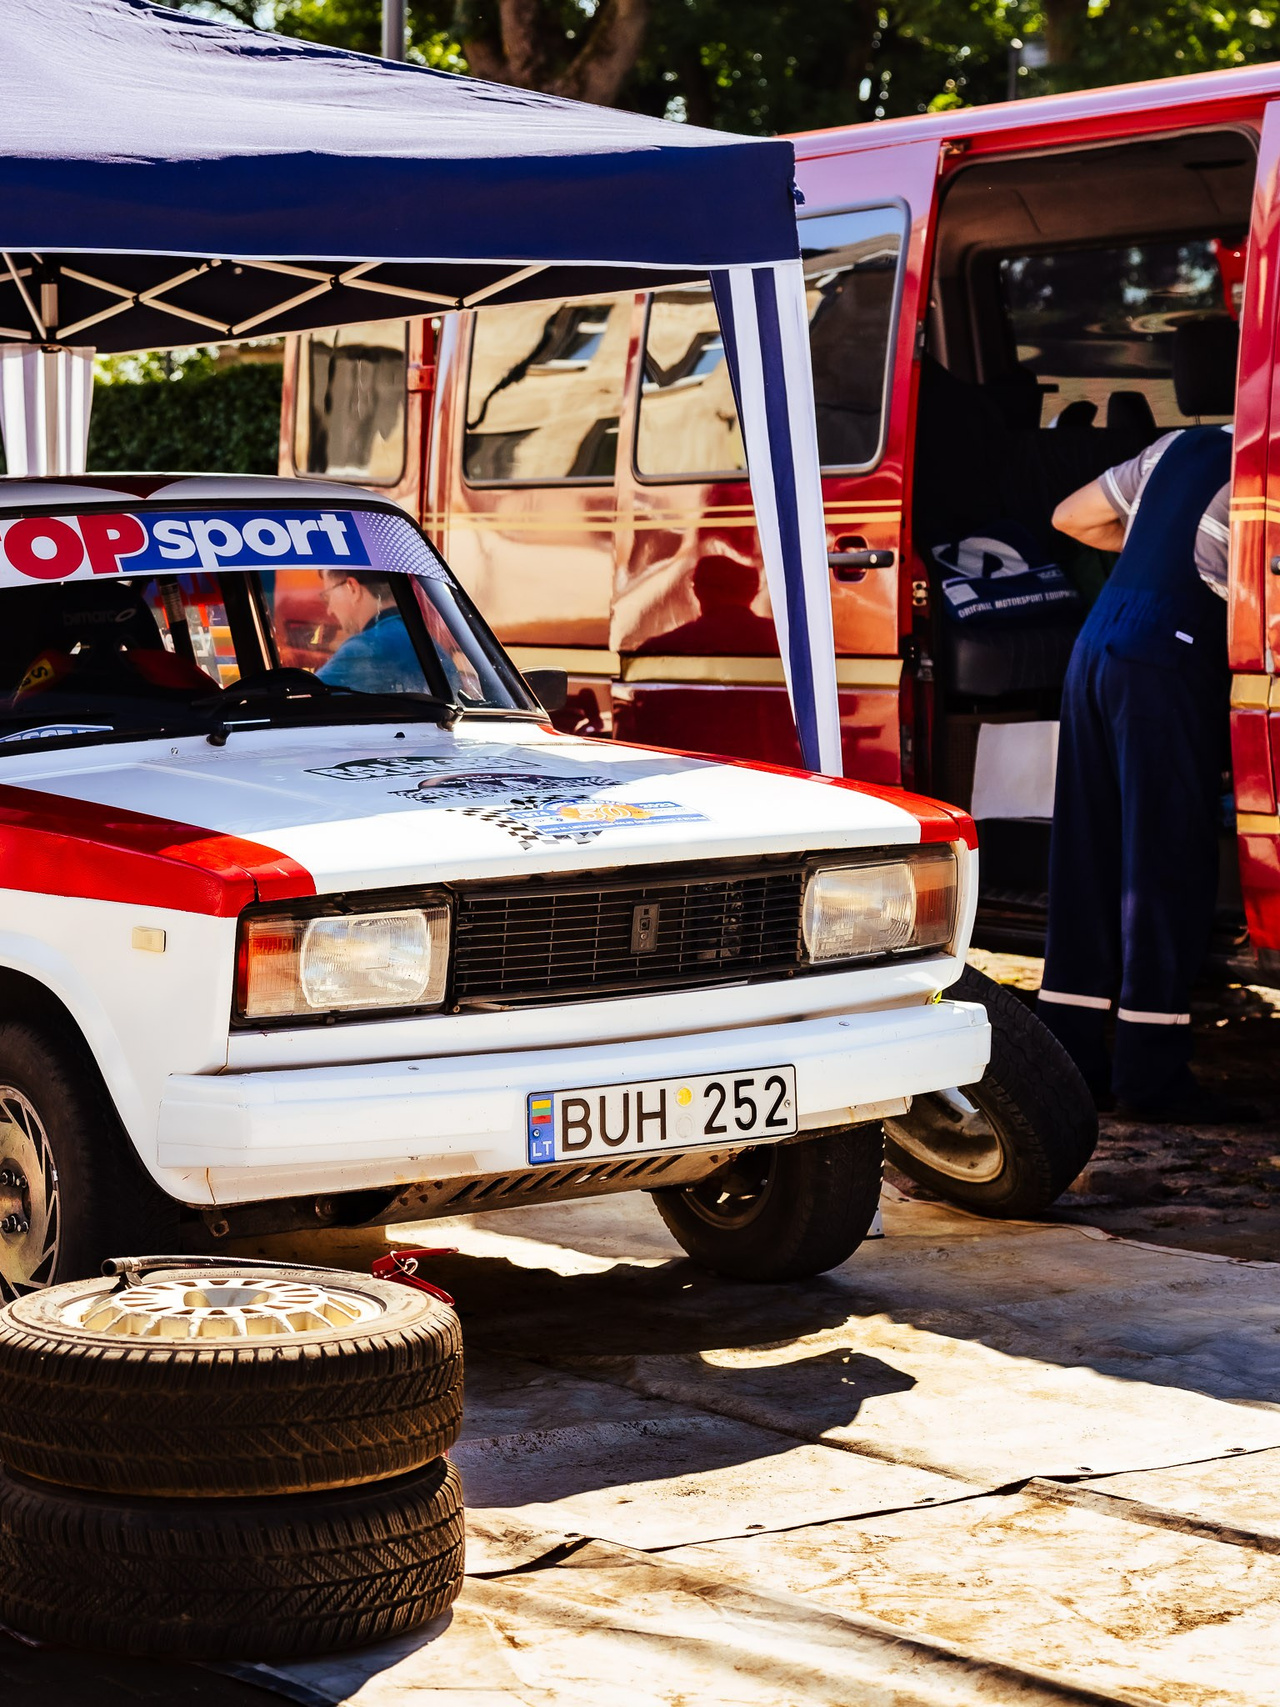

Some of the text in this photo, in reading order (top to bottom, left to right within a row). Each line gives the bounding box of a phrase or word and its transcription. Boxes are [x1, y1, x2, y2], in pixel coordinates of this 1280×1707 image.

[995, 593, 1044, 609] MOTORSPORT
[561, 1075, 789, 1152] BUH 252
[531, 1140, 553, 1158] LT
